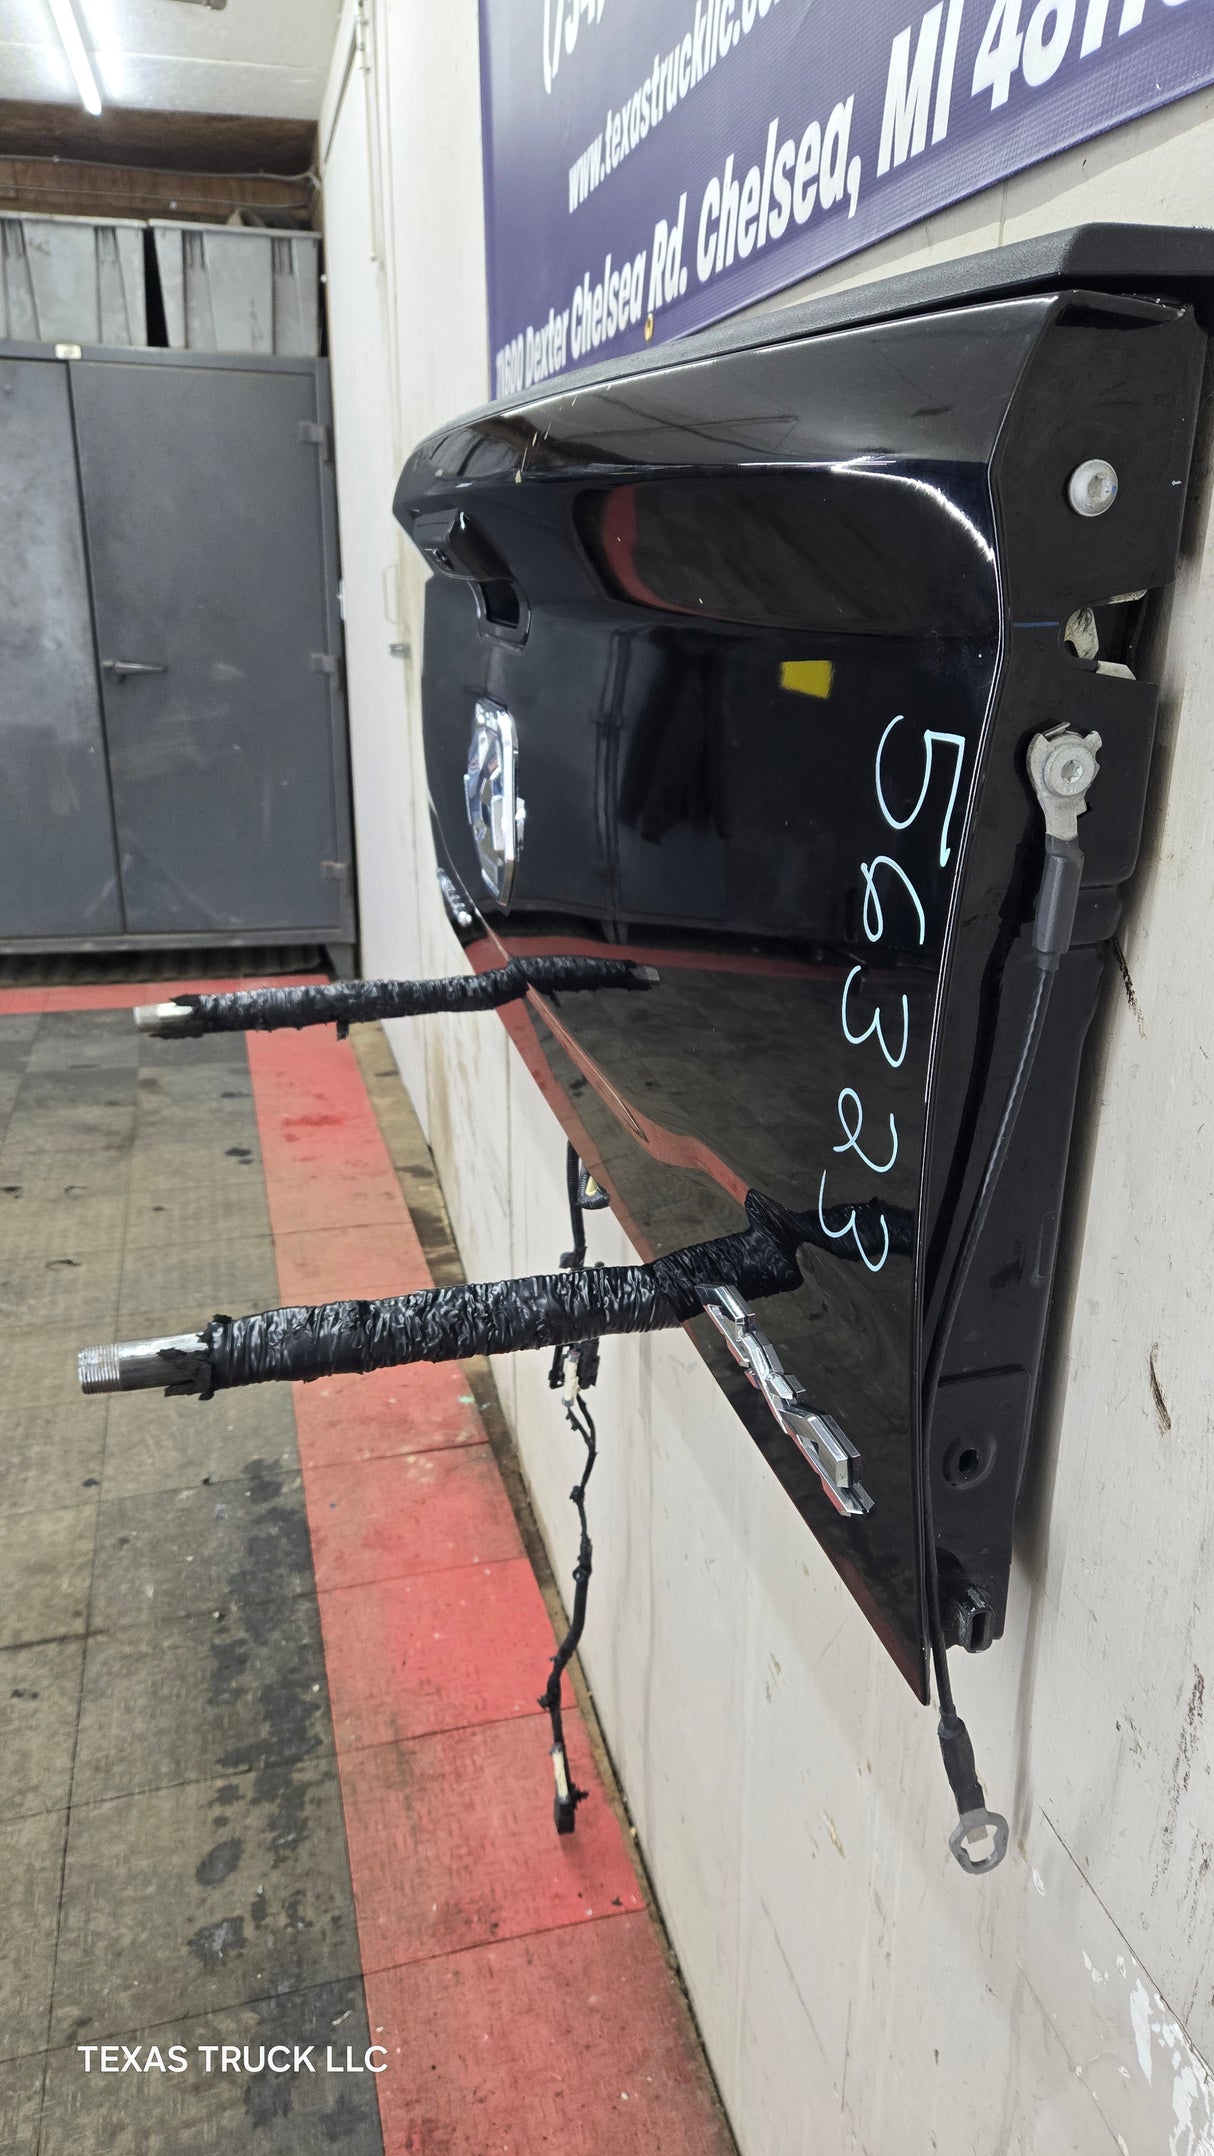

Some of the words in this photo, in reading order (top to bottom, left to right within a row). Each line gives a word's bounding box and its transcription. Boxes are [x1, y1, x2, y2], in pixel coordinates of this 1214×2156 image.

[525, 307, 570, 389] Dexter
[570, 250, 647, 361] Chelsea
[647, 191, 688, 313] Rd.
[697, 93, 861, 283] Chelsea,
[876, 0, 964, 179] MI
[568, 0, 784, 214] www.texastruckllc.
